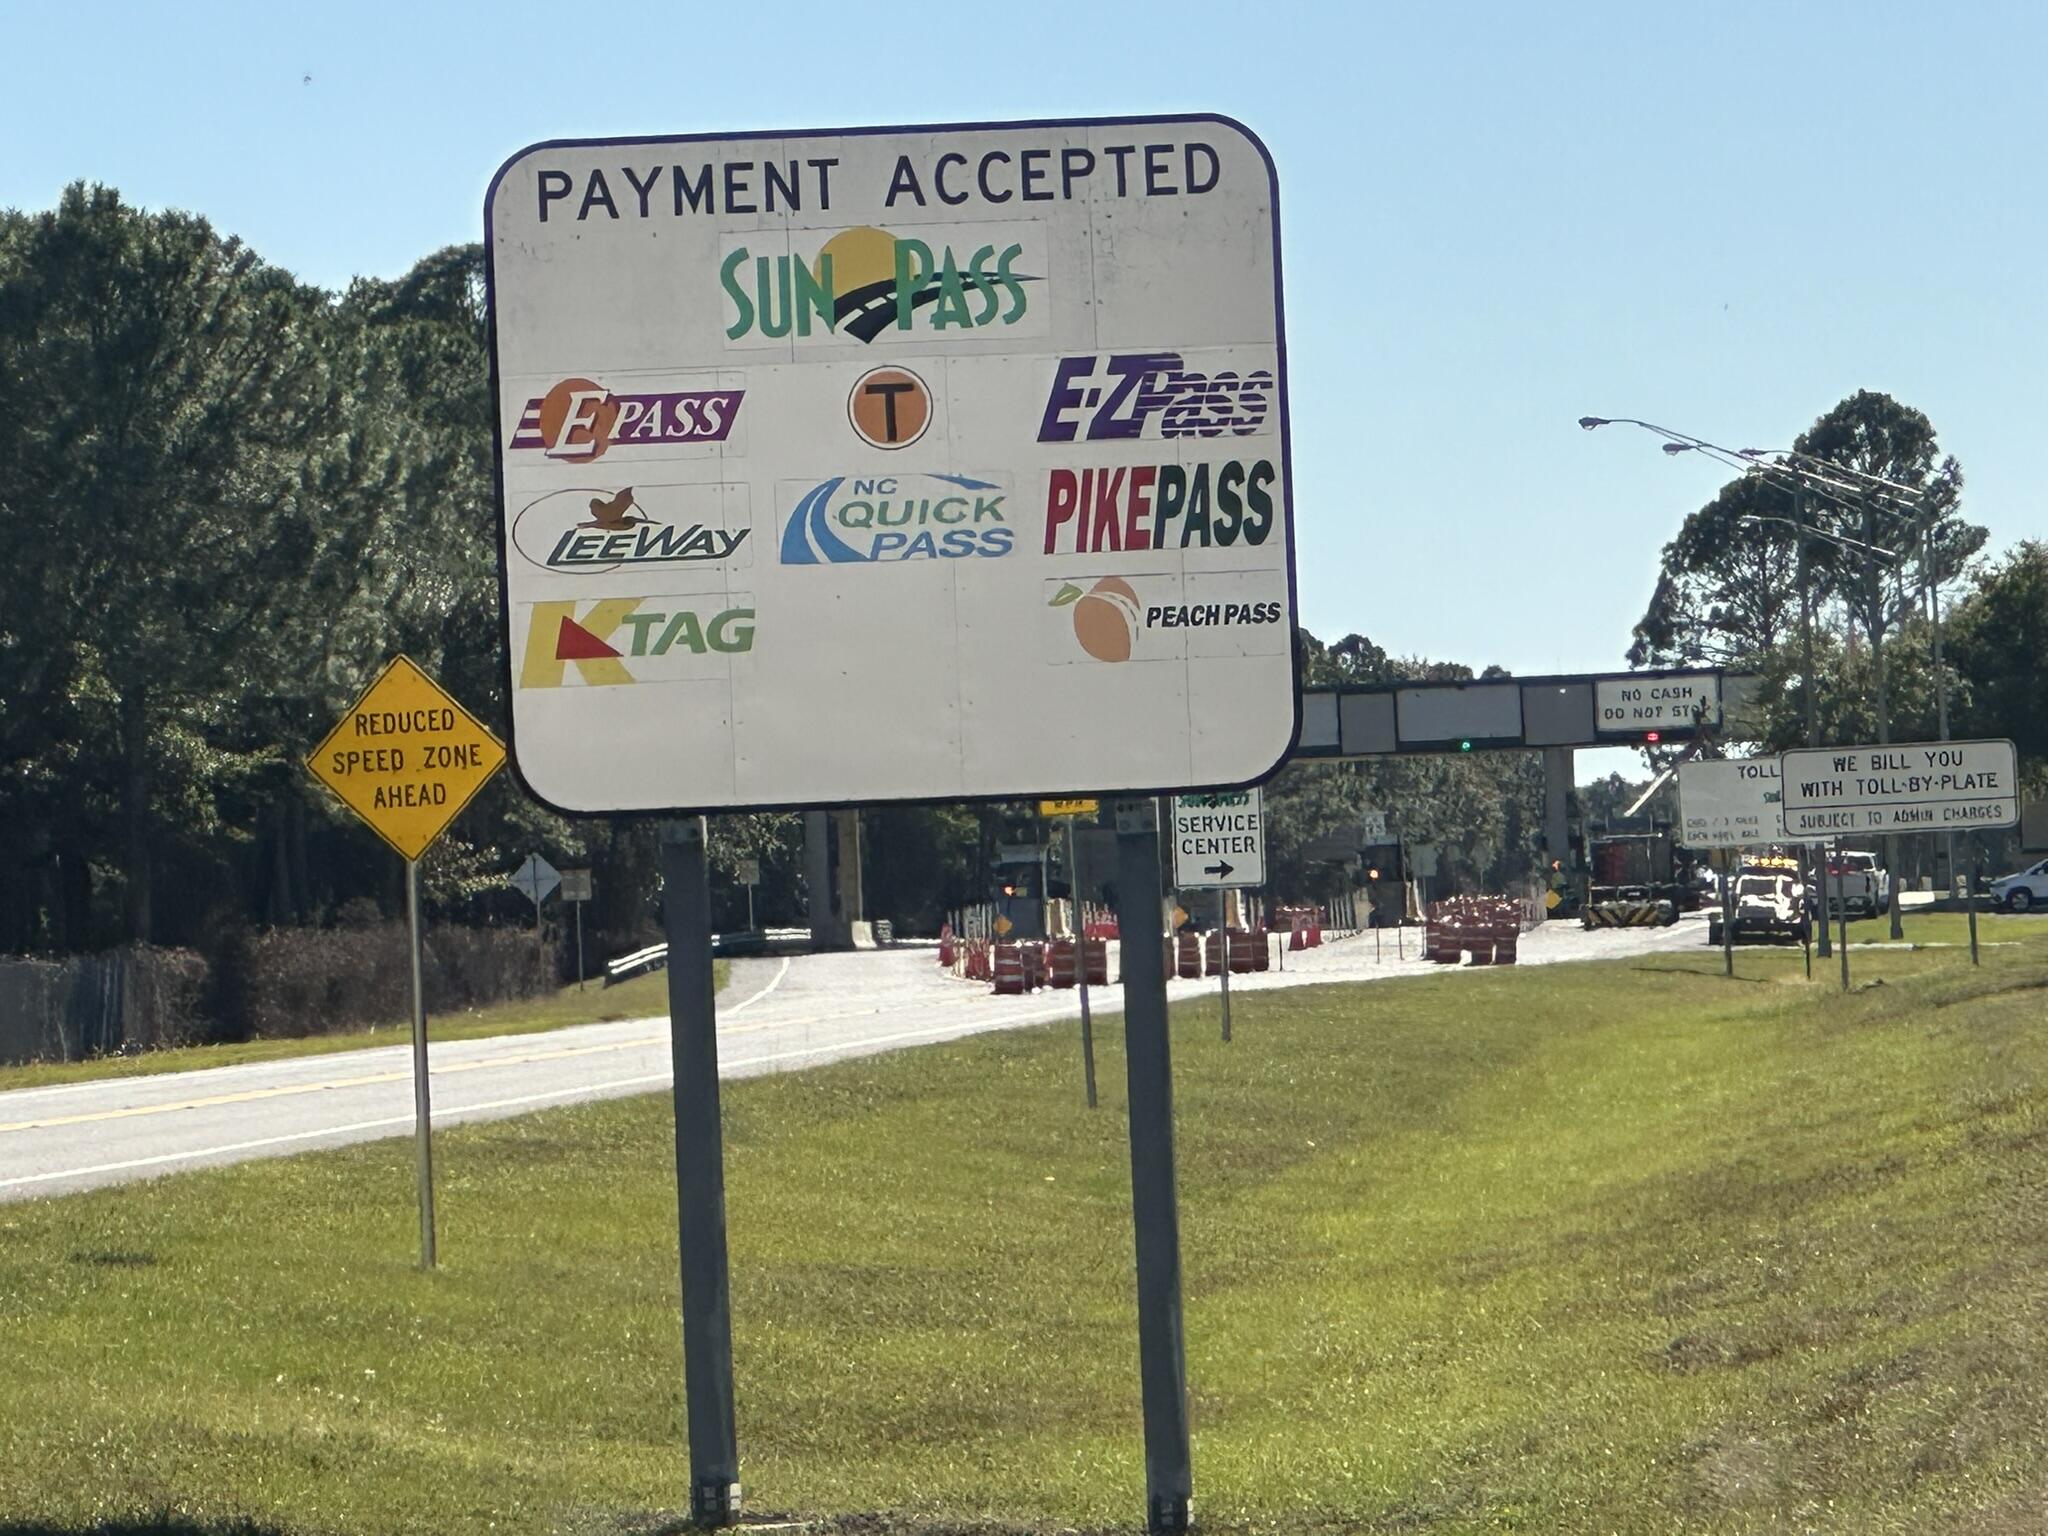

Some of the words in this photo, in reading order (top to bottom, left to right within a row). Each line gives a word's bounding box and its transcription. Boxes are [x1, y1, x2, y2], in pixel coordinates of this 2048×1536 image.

[537, 158, 839, 222] PAYMENT
[885, 143, 1221, 207] ACCEPTED
[720, 246, 835, 341] SUN
[894, 238, 1027, 330] PASS
[1037, 353, 1274, 442] E-ZPass
[864, 382, 915, 443] T
[853, 478, 898, 495] NC
[838, 496, 1007, 528] QUICK
[1043, 460, 1276, 554] PIKEPASS
[869, 528, 1014, 561] PASS
[1146, 605, 1220, 628] PEACH
[1224, 602, 1281, 625] PASS
[1621, 688, 1641, 701] NO
[1650, 687, 1693, 700] CASH
[355, 708, 454, 736] REDUCED
[1604, 708, 1625, 720] DO
[1633, 706, 1663, 718] NOT
[332, 748, 404, 776] SPEED
[423, 743, 482, 769] ZONE
[1737, 764, 1781, 779] TOLL
[1833, 755, 1858, 773] WE
[1870, 753, 1911, 771] BILL
[1925, 750, 1963, 768] YOU
[373, 783, 447, 809] AHEAD
[1800, 780, 1843, 798] WITH
[1178, 814, 1259, 834] SERVICE
[1799, 811, 1855, 829] SUBJECT
[1867, 810, 1883, 825] TO
[1893, 806, 1934, 823] ADMIN
[1943, 803, 2003, 821] CHARGES
[1181, 836, 1256, 856] CENTER
